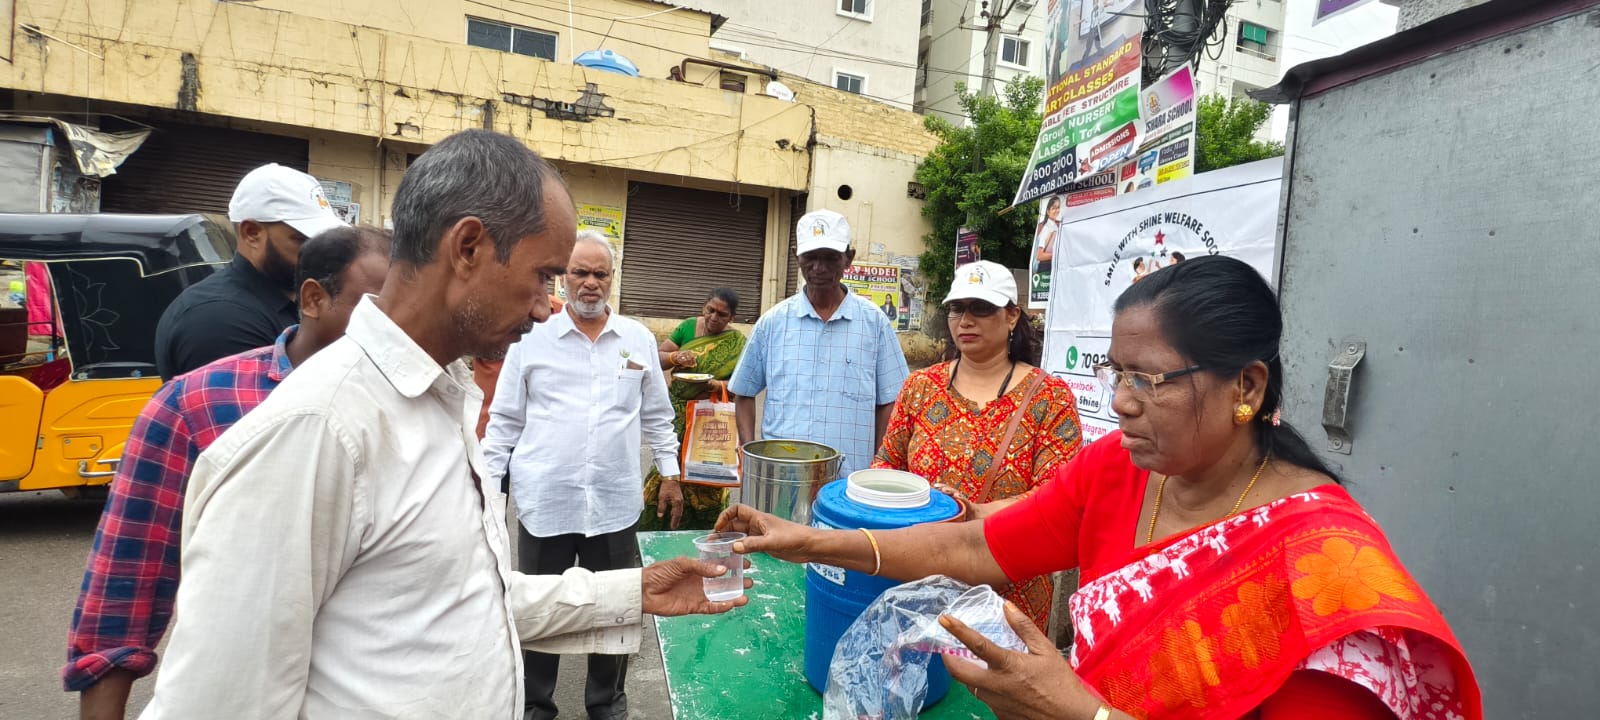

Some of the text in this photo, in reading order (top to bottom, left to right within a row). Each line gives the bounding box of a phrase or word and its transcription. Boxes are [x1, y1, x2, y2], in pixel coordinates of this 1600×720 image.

[1083, 41, 1132, 79] STANDARD
[1081, 76, 1130, 110] STRUCTURE
[1068, 98, 1117, 130] NURSERY
[1167, 98, 1193, 124] SCHOOL
[1038, 135, 1070, 160] LASSES
[1090, 128, 1131, 158] ADMISSIONS
[1100, 144, 1129, 169] OPEN
[1033, 164, 1051, 181] 800
[1078, 173, 1114, 189] SCHOOL
[1104, 251, 1121, 287] SMILE
[1118, 227, 1138, 251] WITH
[1139, 213, 1162, 233] SHINE
[1164, 211, 1204, 235] WELFARE
[843, 273, 897, 284] HIGH SCHOOL
[864, 267, 897, 277] MODEL
[1078, 395, 1100, 408] Shine
